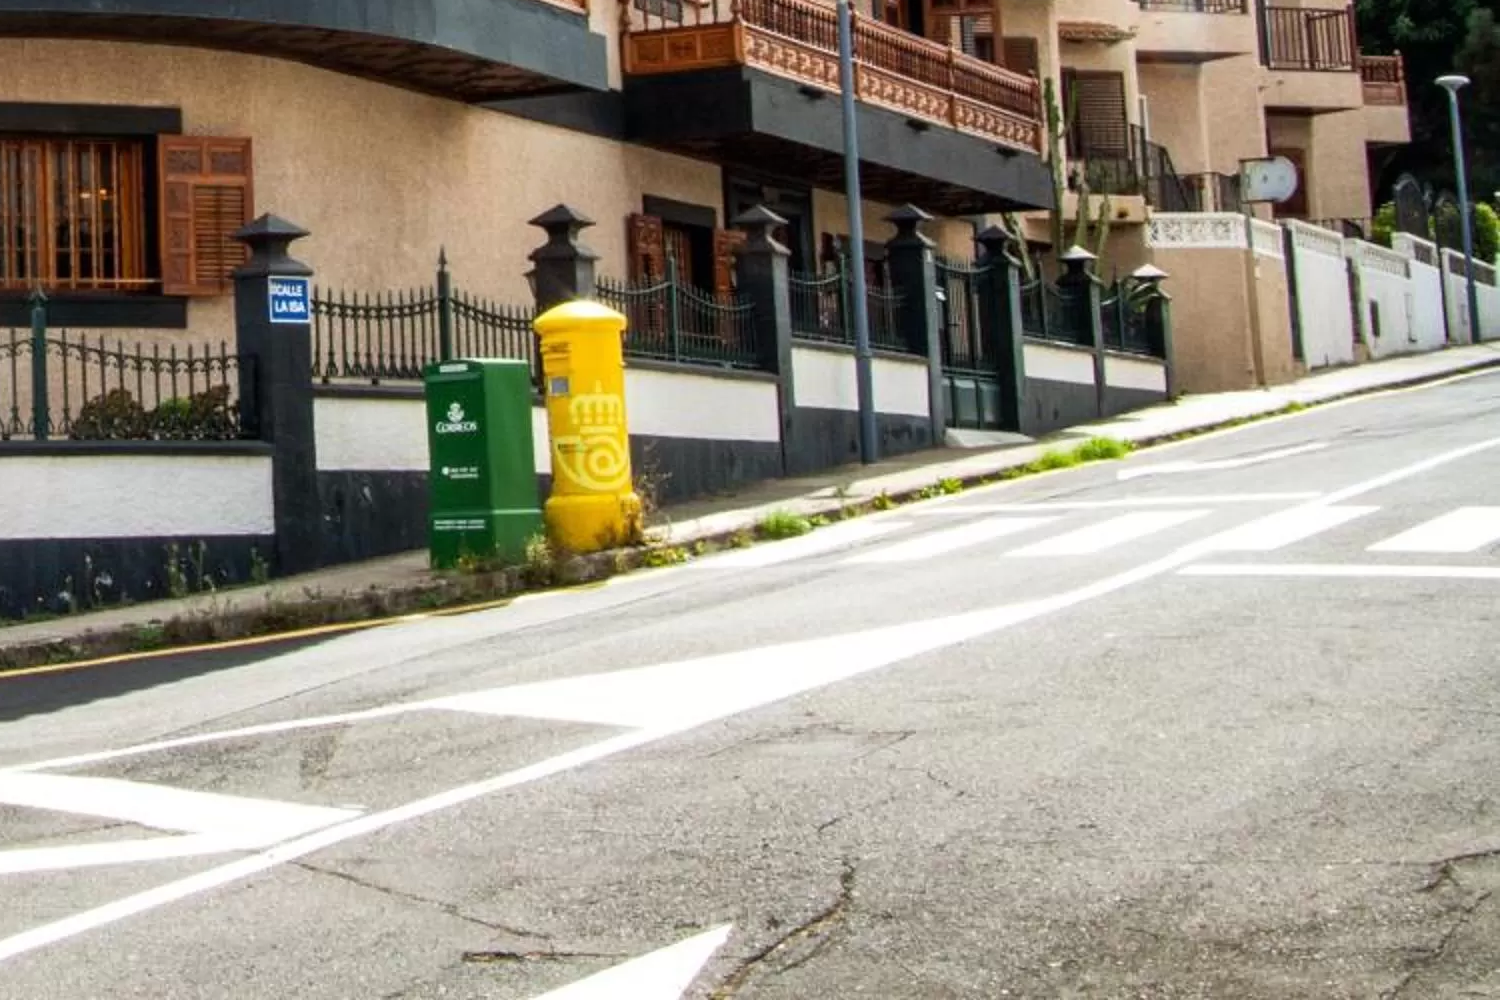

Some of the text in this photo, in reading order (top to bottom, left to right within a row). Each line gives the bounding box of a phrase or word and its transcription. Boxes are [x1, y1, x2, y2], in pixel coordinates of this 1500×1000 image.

[276, 283, 303, 297] CALLE
[275, 300, 289, 313] LA
[435, 420, 478, 434] CORREOS
